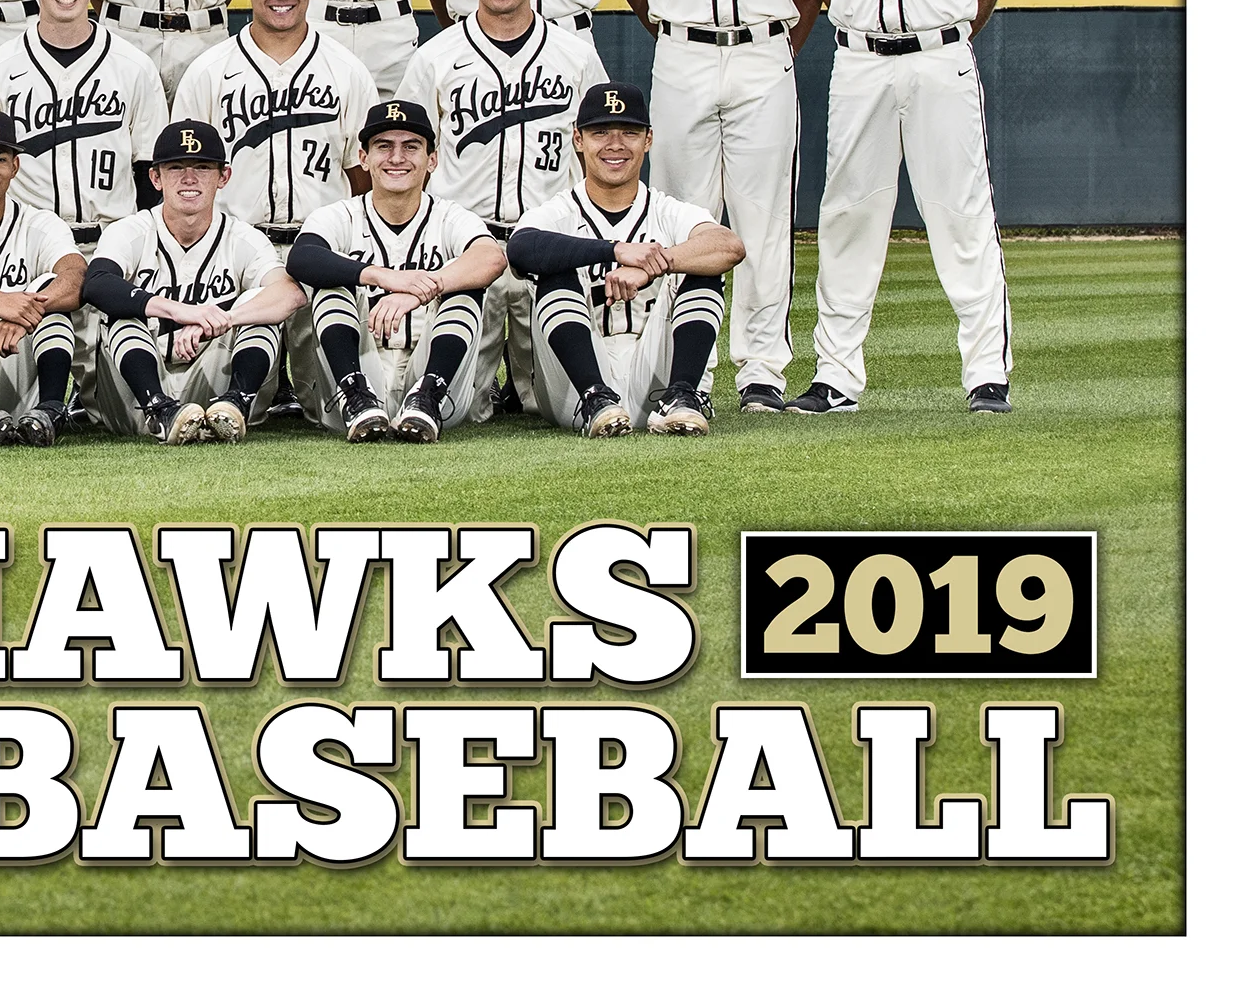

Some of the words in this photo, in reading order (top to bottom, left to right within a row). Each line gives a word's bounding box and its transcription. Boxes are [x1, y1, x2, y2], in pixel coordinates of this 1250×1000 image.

[8, 79, 125, 134] Hawks
[221, 74, 340, 143] Hawks
[451, 66, 573, 136] Hawks
[90, 149, 116, 190] 19
[301, 139, 331, 182] 24
[534, 131, 562, 172] 33
